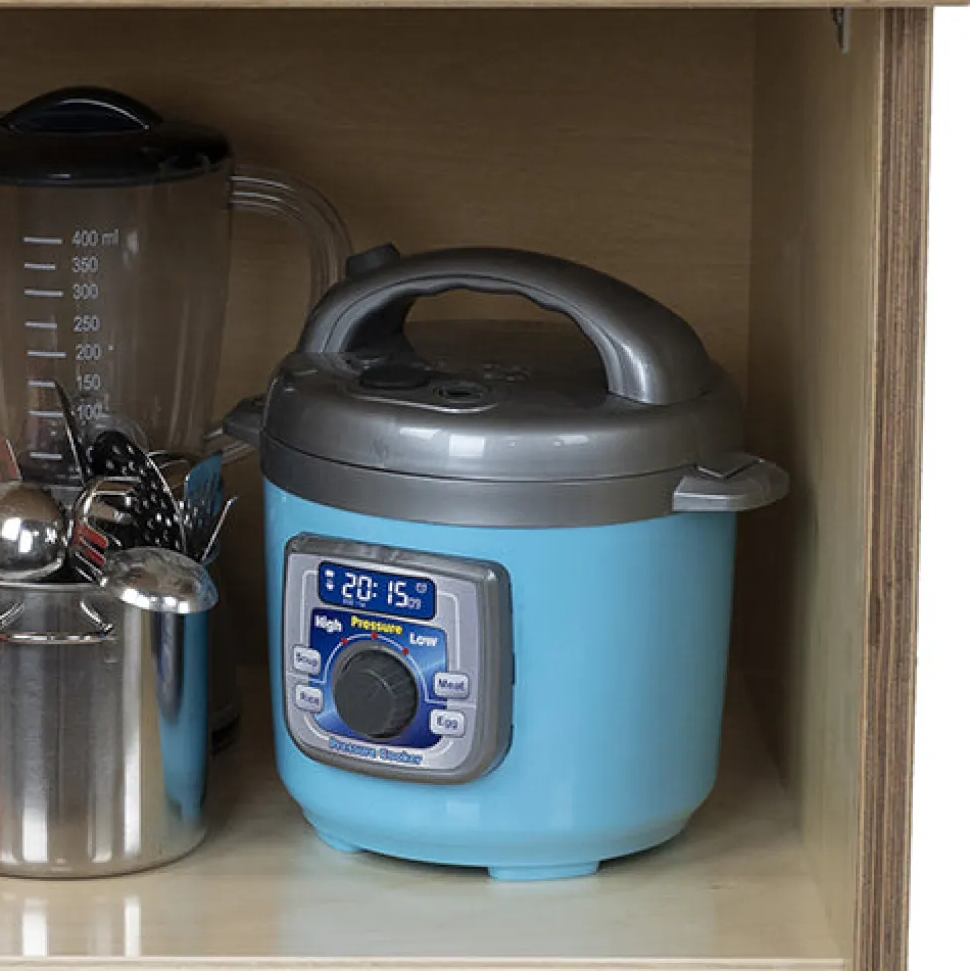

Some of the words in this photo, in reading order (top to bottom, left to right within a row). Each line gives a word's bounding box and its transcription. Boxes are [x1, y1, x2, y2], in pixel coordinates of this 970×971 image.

[72, 230, 98, 247] 400
[101, 229, 119, 246] ml
[72, 256, 99, 273] 350
[72, 283, 99, 300] 300
[73, 315, 100, 332] 250
[75, 344, 102, 361] 200
[76, 373, 101, 391] 150
[314, 615, 343, 632] High
[351, 615, 403, 635] Pressure
[410, 632, 438, 647] Low
[438, 678, 465, 692] Meat
[436, 715, 459, 730] Egg
